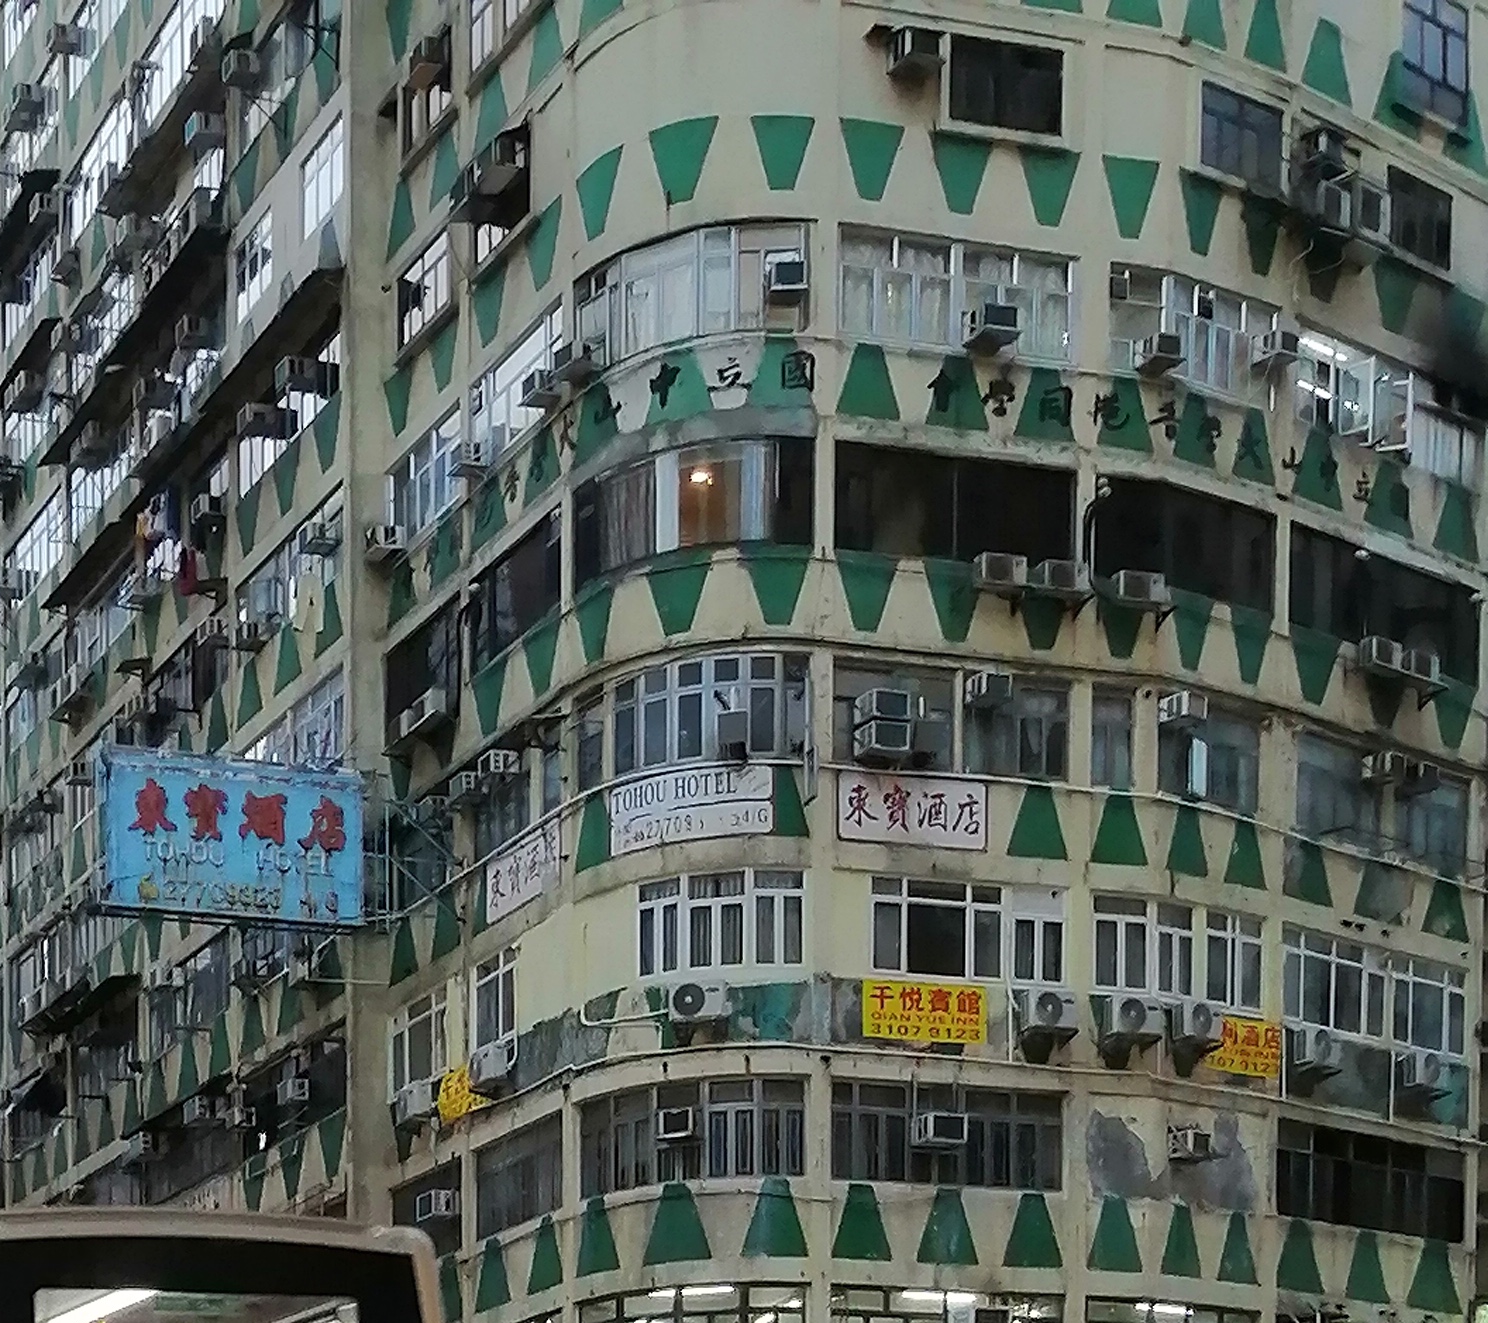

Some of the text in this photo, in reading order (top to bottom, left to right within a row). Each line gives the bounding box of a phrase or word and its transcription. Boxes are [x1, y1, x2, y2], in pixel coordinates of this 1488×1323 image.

[613, 771, 738, 815] TOHOU HOTEL
[844, 784, 981, 835] 東寶酒店
[870, 1010, 979, 1026] QIAN YUE INN
[871, 1023, 921, 1036] 3107
